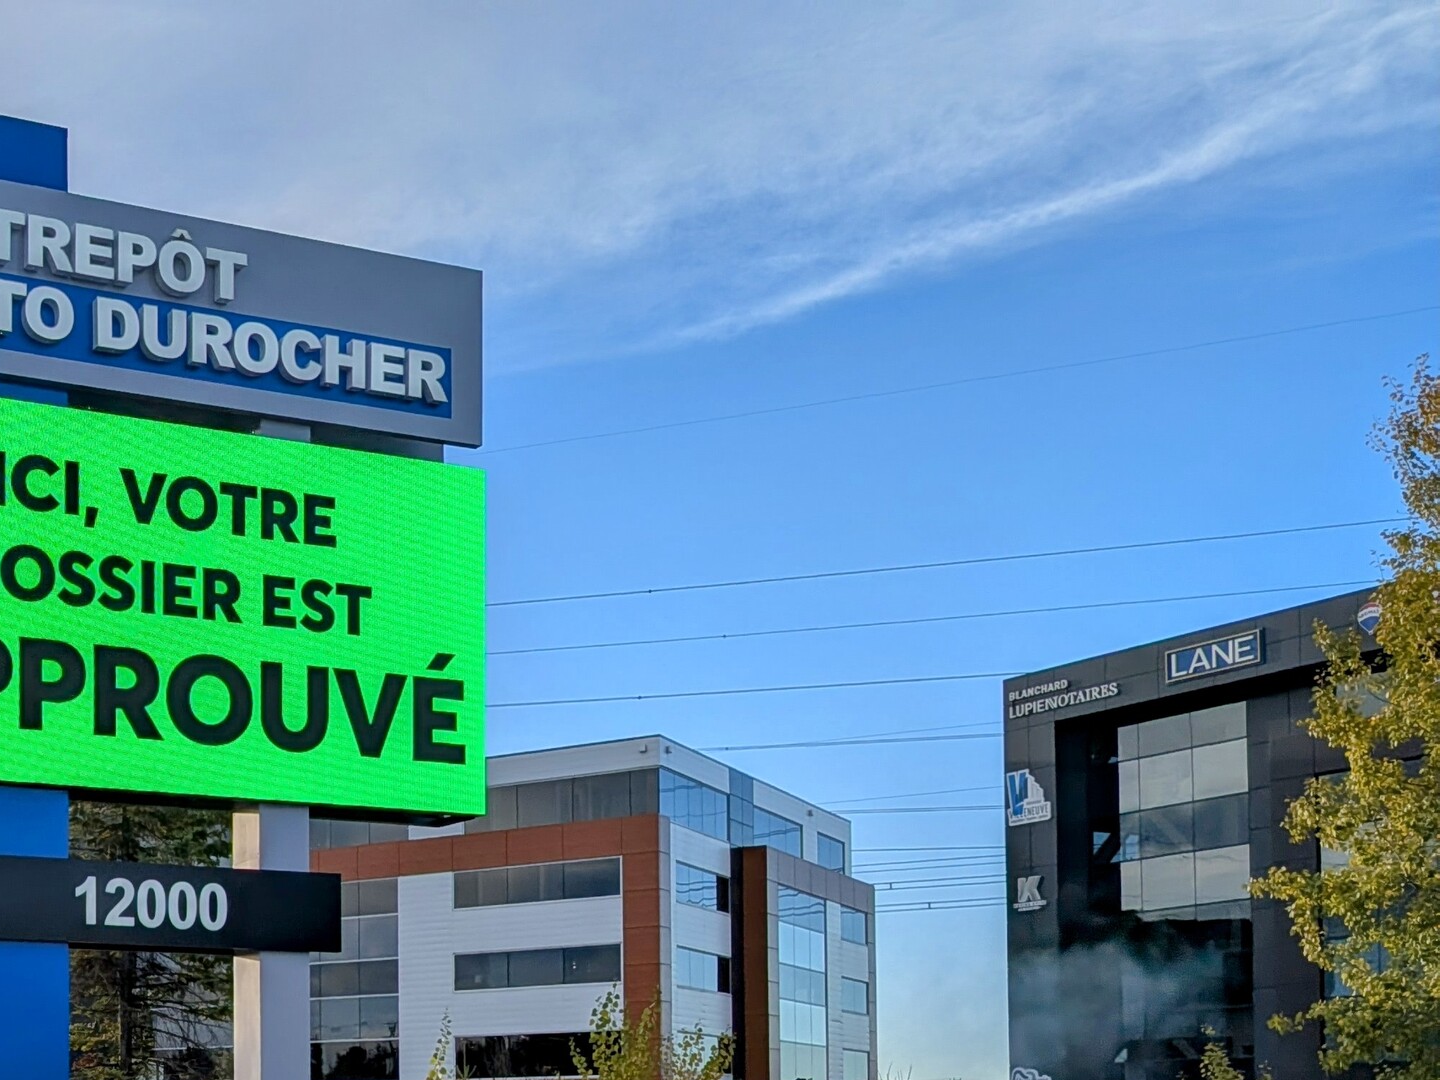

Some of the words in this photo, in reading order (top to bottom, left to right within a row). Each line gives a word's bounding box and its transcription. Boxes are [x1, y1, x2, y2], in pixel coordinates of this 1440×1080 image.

[92, 296, 449, 405] DUROCHER
[120, 468, 337, 548] VOTRE
[263, 578, 372, 636] EST
[1170, 635, 1255, 678] LANE
[1008, 680, 1068, 702] BLANCHARD
[74, 875, 228, 932] 12000
